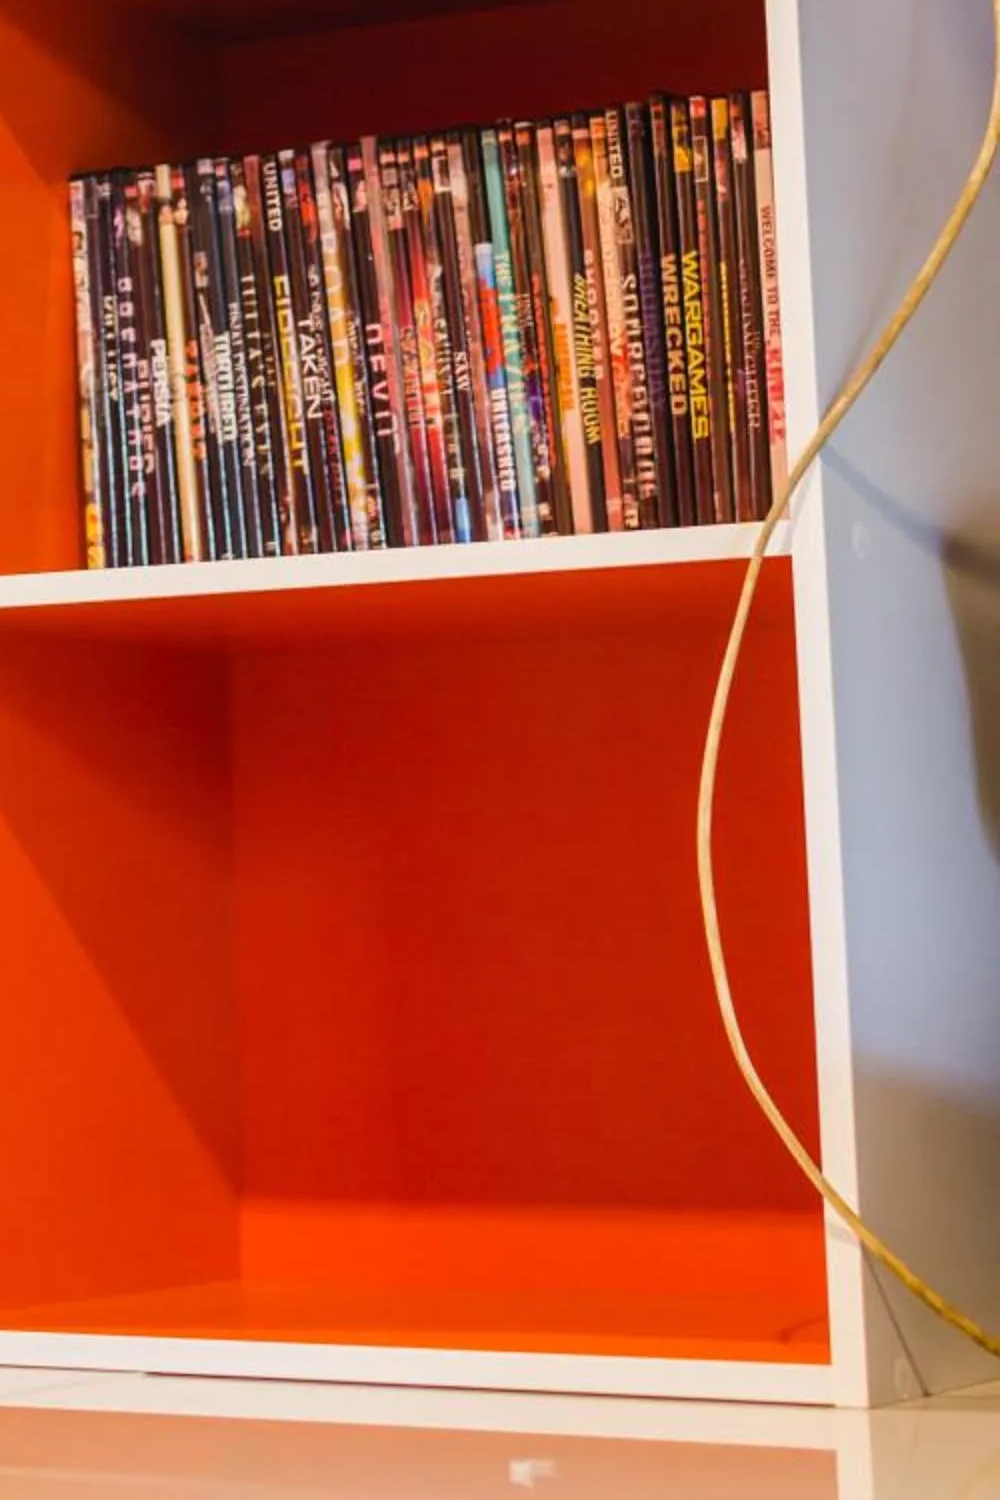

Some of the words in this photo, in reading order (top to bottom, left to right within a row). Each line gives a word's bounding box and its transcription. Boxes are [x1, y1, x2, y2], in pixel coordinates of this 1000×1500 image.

[604, 110, 623, 178] UNITED
[262, 160, 282, 232] UNITED
[760, 205, 774, 279] WELCOME
[766, 286, 777, 304] TO
[767, 309, 779, 337] THE
[297, 317, 323, 419] TAKEN
[658, 253, 686, 416] WRECKED
[680, 250, 711, 442] WARGAMES
[149, 338, 171, 427] PERSIA
[452, 350, 470, 393] SAW
